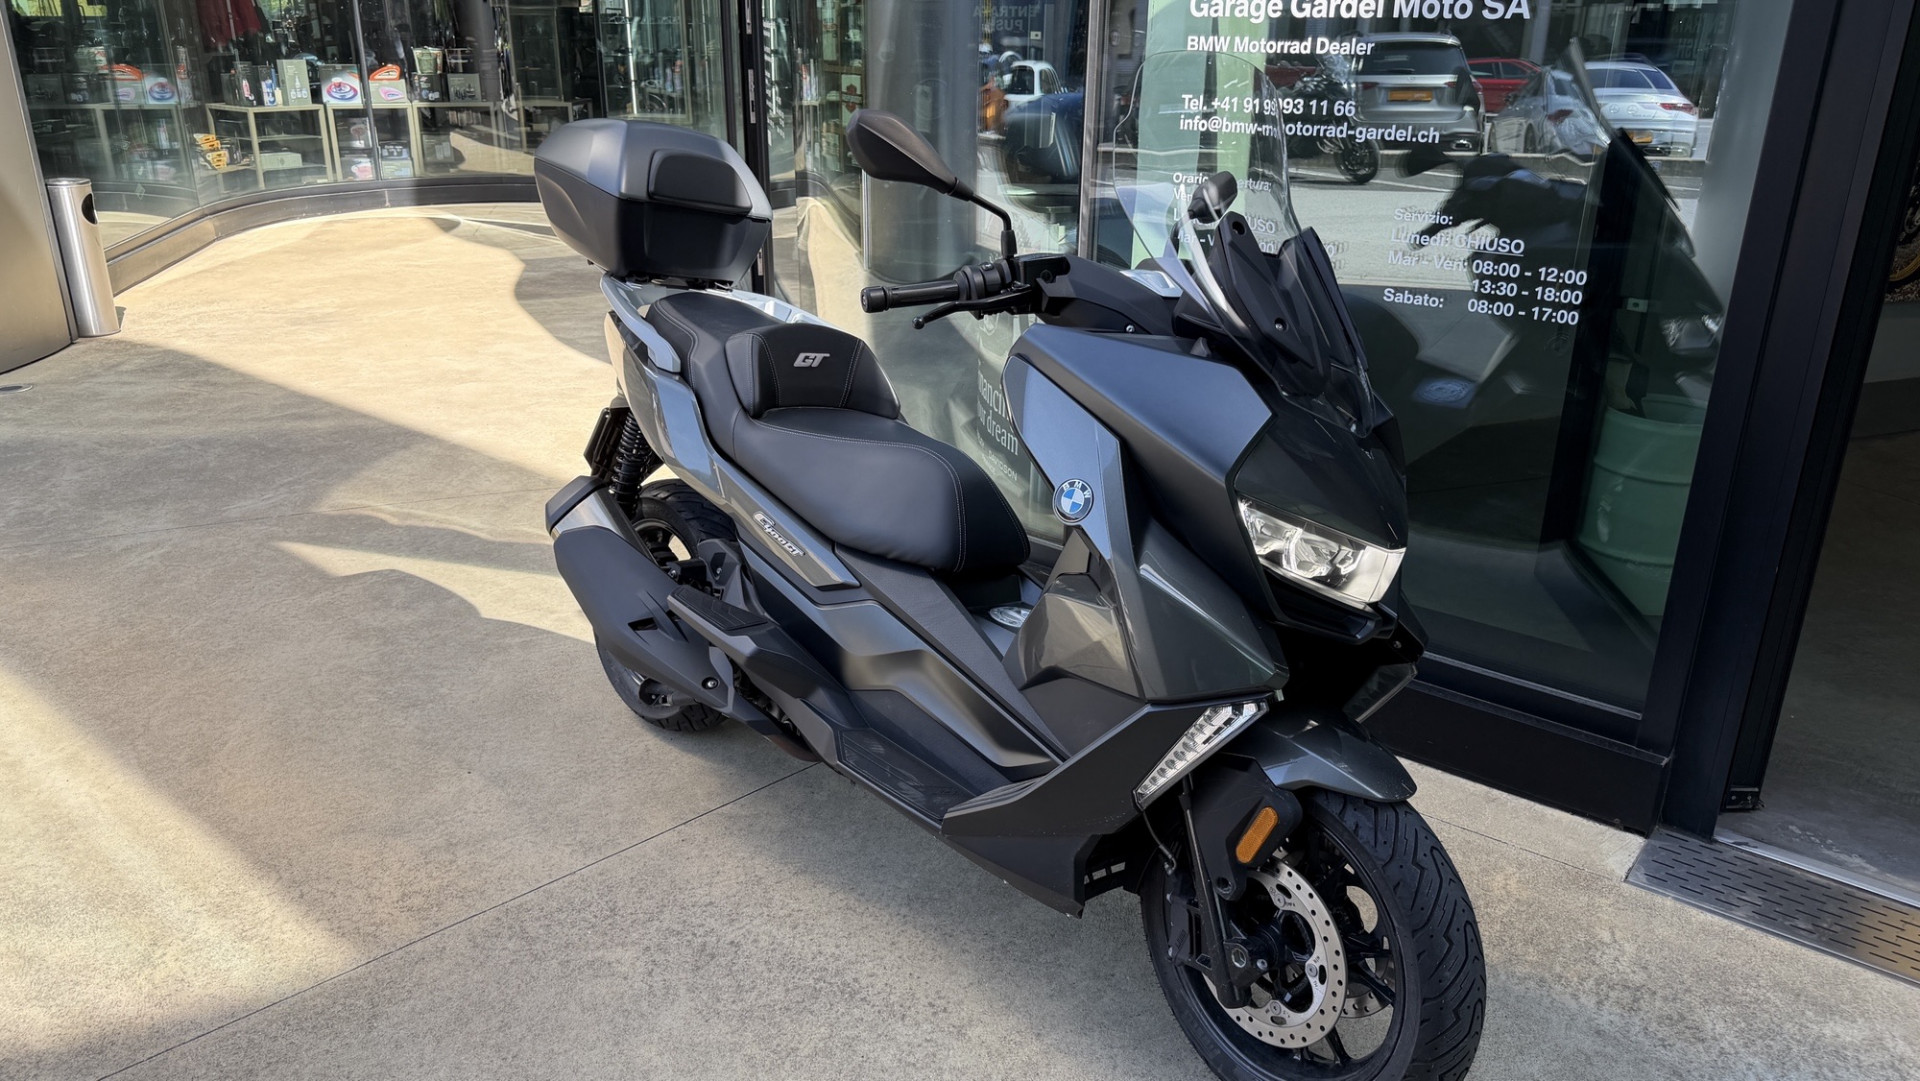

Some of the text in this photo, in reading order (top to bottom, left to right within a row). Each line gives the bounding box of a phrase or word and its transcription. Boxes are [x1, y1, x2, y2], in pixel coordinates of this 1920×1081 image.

[1190, 0, 1531, 24] Garage Gardel Moto SA
[1187, 35, 1375, 56] BMW Motorrad Dealer
[1181, 94, 1207, 111] Tel.
[1211, 96, 1238, 113] +41
[1243, 97, 1260, 114] 91
[1309, 99, 1328, 116] 11
[1333, 100, 1356, 117] 66
[1393, 208, 1454, 226] Servizio:
[1454, 233, 1525, 255] CHIUSO
[1387, 250, 1418, 266] Mar
[1472, 259, 1521, 279] 08:00
[1538, 266, 1588, 286] 12:00
[1472, 278, 1518, 298] 13:30
[1535, 286, 1583, 306] 18:00
[1382, 287, 1444, 309] Sabato:
[1467, 298, 1515, 318] 08:00
[1531, 306, 1580, 326] 17:00
[793, 352, 831, 368] GT
[986, 409, 1019, 457] dream
